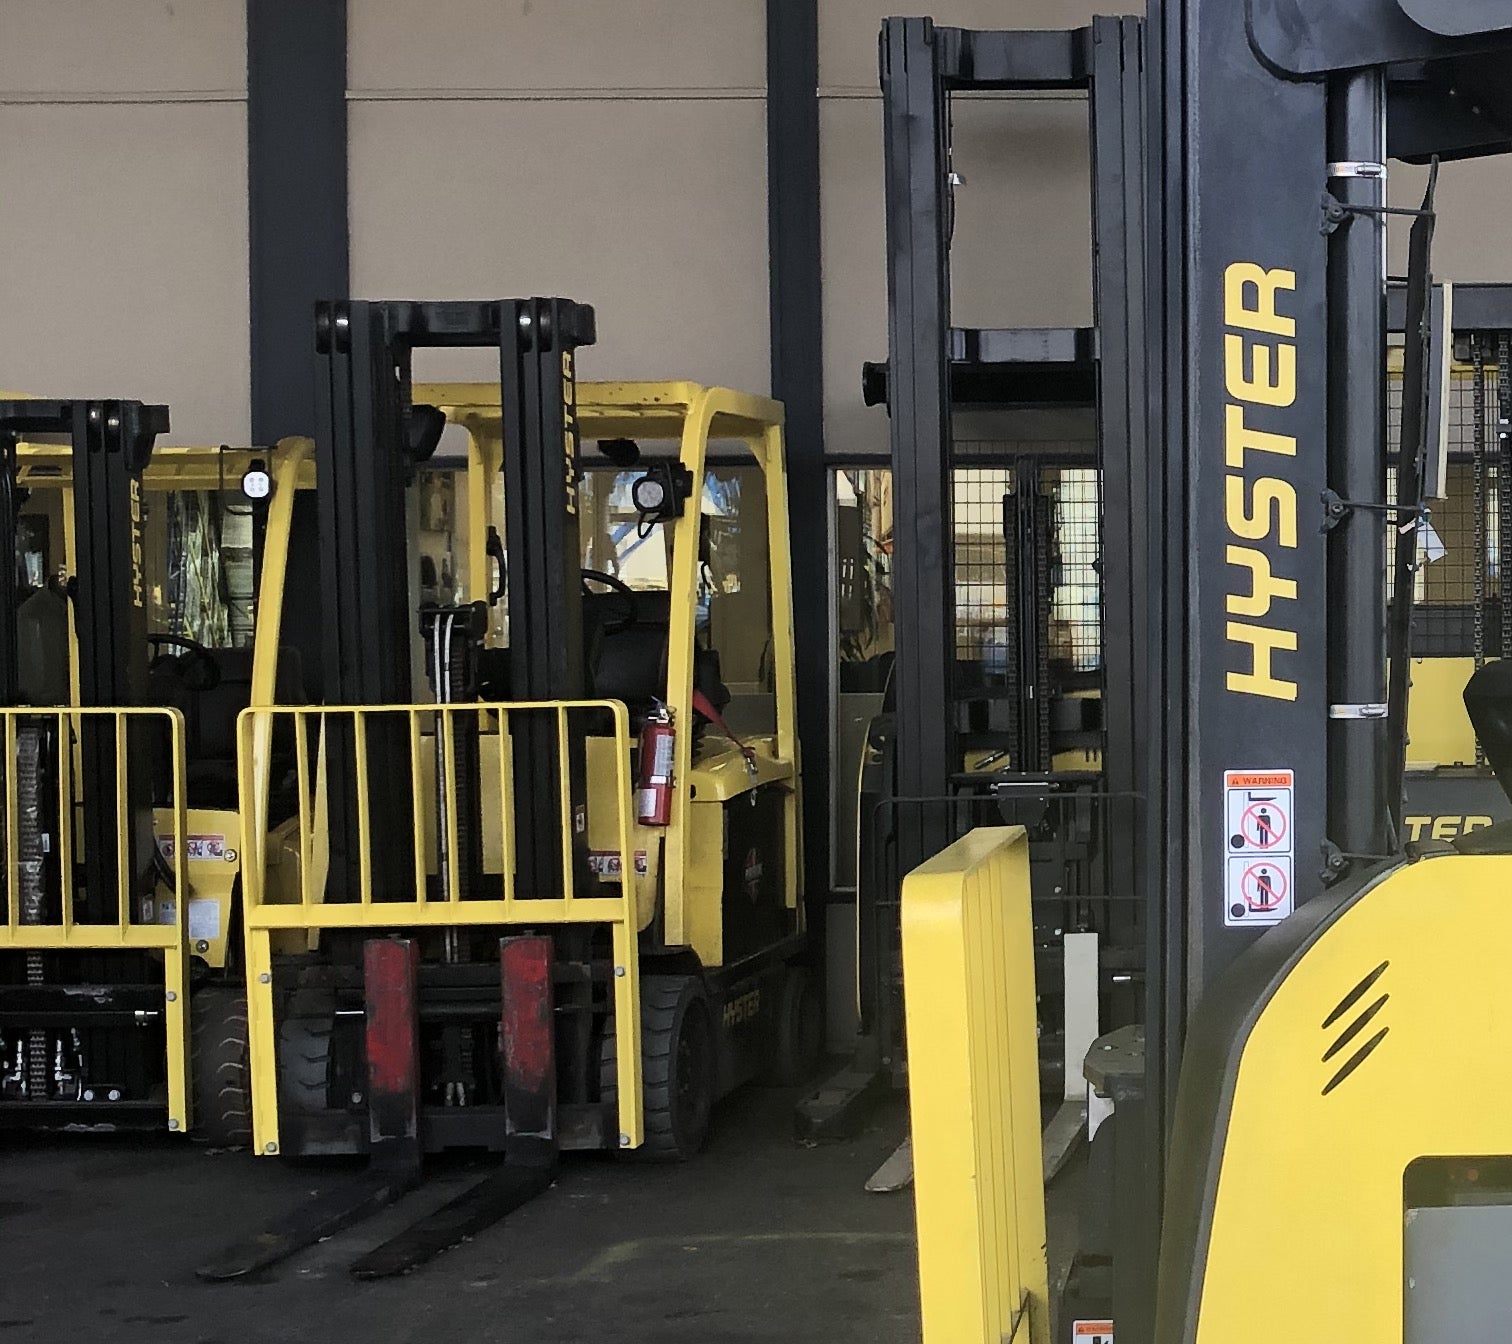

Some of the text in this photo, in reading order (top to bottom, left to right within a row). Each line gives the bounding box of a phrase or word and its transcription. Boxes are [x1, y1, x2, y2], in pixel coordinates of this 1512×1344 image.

[562, 350, 576, 515] HYSTER
[1225, 262, 1297, 702] HYSTER
[130, 478, 143, 608] HYSTER
[1243, 777, 1287, 785] WARNING
